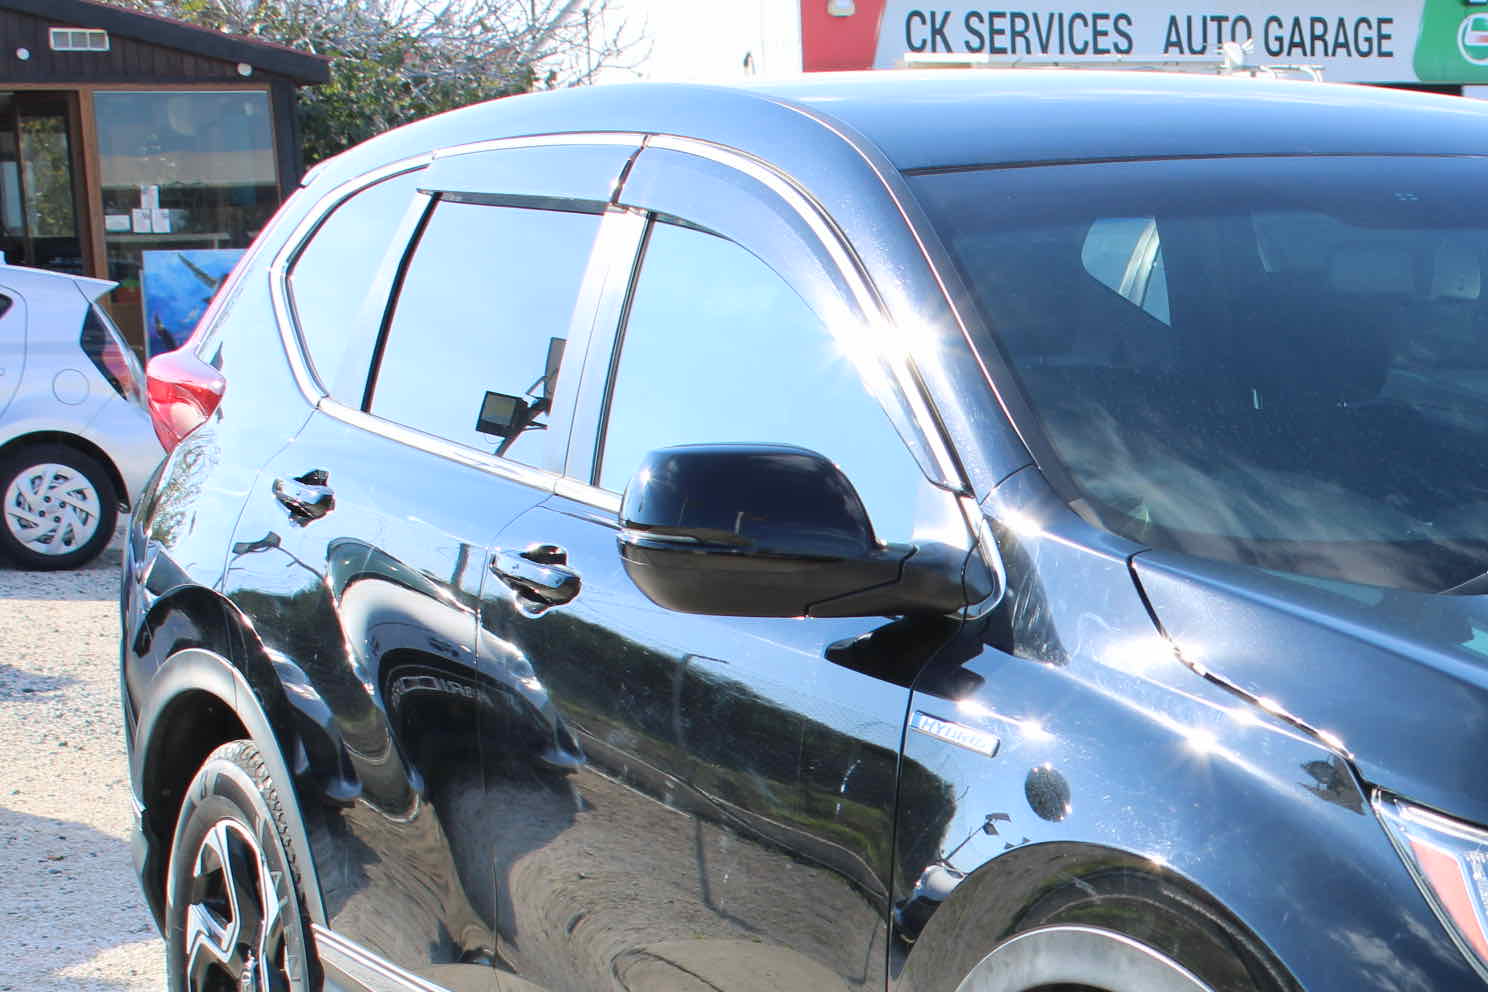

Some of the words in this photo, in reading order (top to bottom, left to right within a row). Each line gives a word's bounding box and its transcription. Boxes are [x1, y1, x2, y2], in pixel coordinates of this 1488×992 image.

[905, 10, 952, 54] CK
[963, 10, 1134, 56] SERVICES
[1162, 15, 1252, 56] AUTO
[1263, 16, 1395, 58] GARAGE
